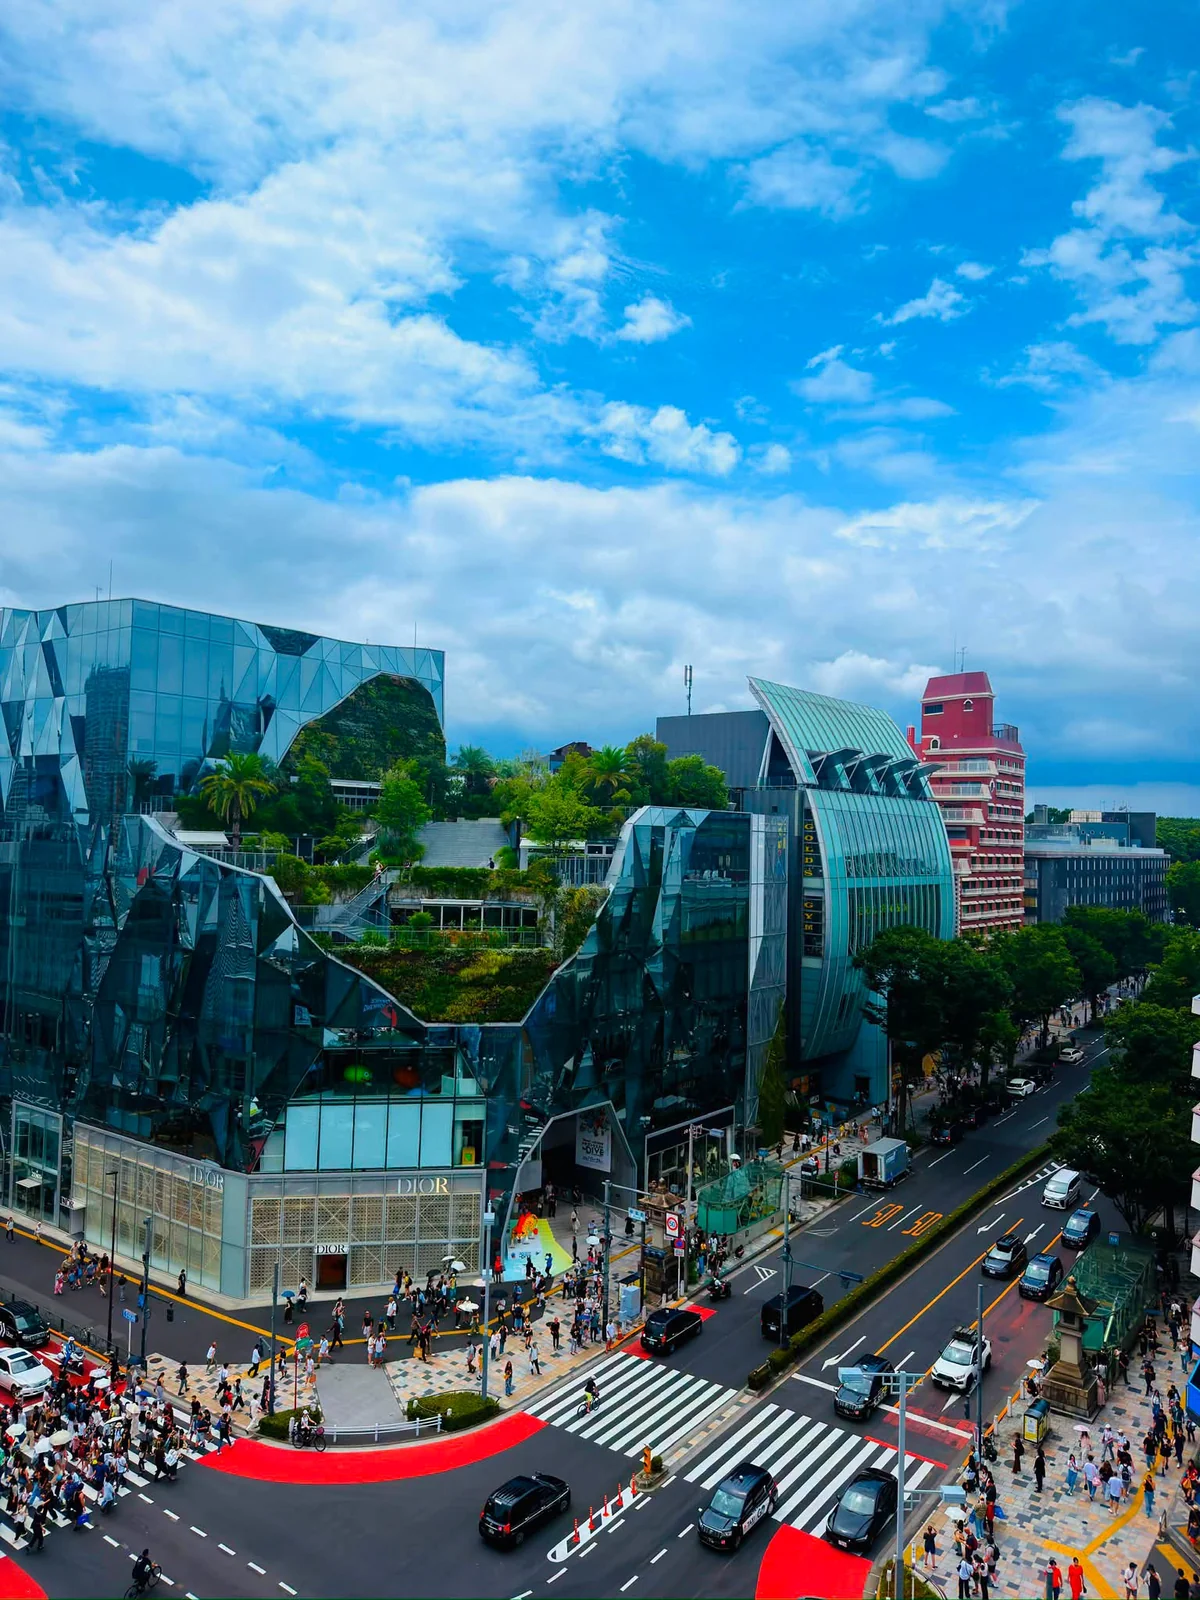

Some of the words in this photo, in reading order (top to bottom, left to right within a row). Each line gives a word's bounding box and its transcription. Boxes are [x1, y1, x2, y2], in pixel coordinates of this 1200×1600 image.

[804, 901, 814, 931] GYM
[397, 1177, 449, 1194] DIOR
[861, 1203, 904, 1228] 50
[901, 1211, 943, 1236] 50
[316, 1244, 345, 1254] DIOR
